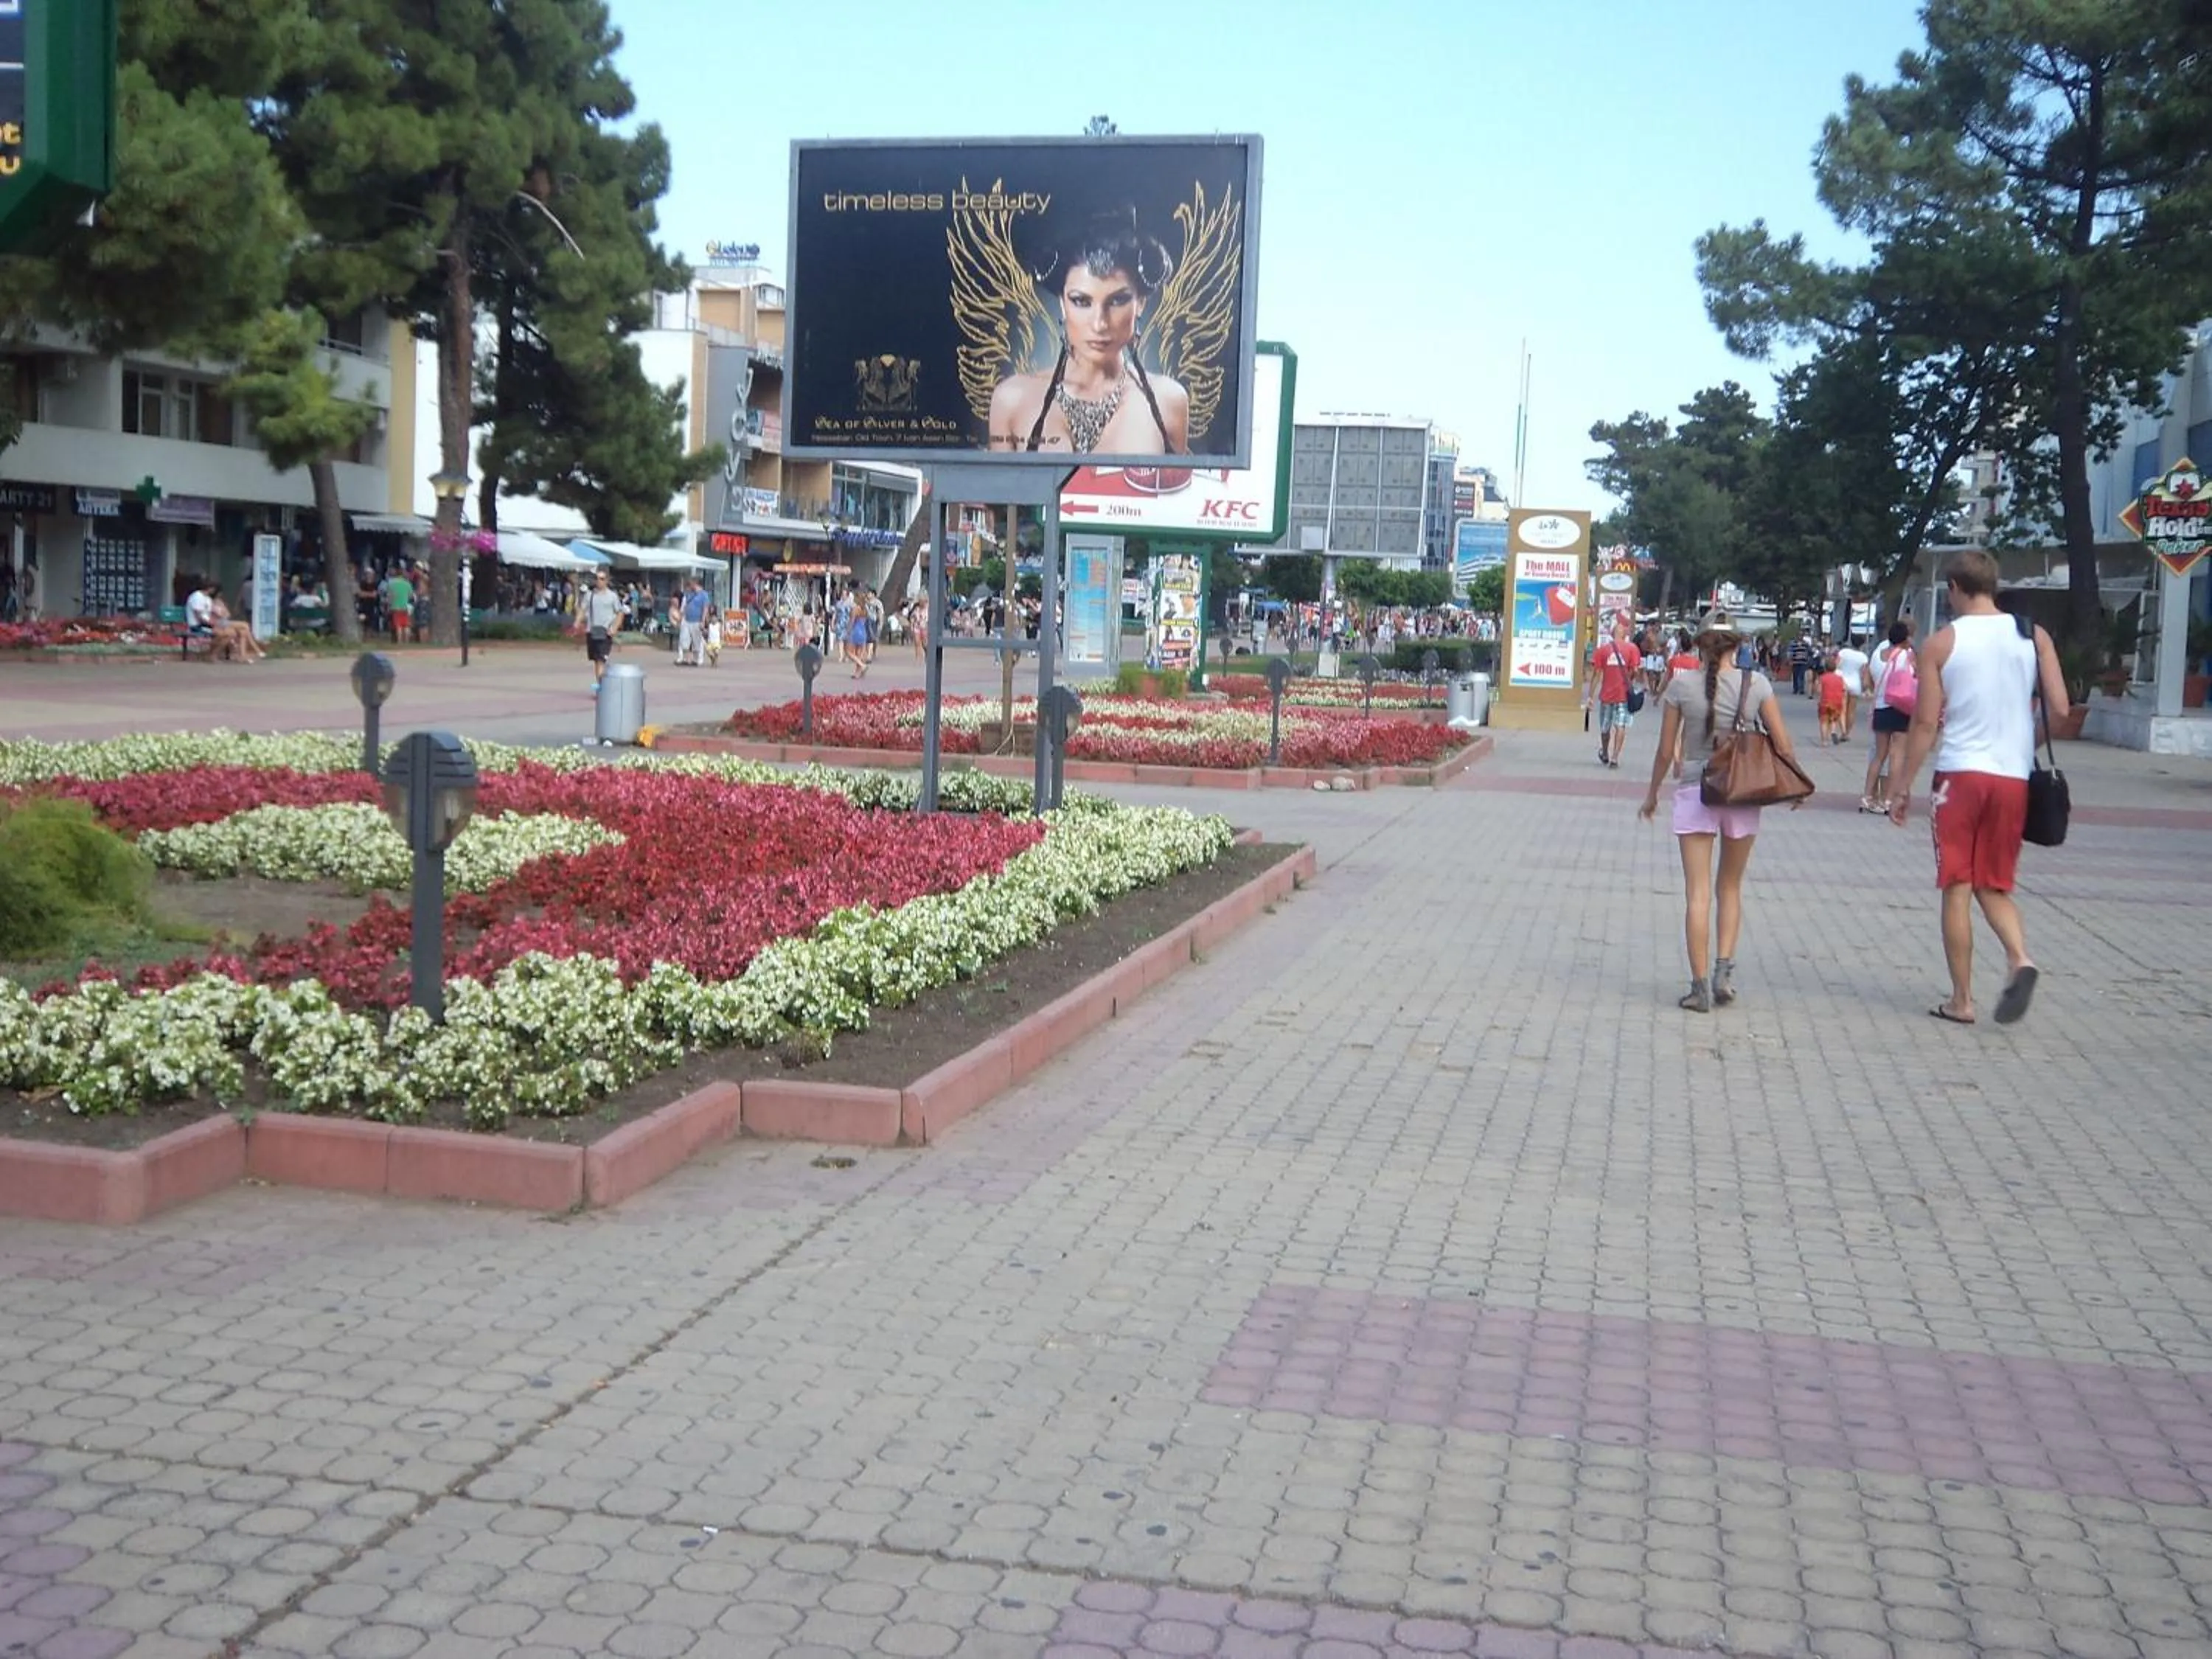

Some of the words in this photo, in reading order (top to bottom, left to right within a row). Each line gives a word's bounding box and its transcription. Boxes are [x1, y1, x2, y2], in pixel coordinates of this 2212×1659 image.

[824, 189, 943, 212] timeless
[951, 189, 1051, 215] beauty
[1200, 498, 1260, 520] KFC
[1525, 560, 1543, 571] The
[1545, 560, 1570, 572] MALL
[1534, 663, 1552, 675] 100
